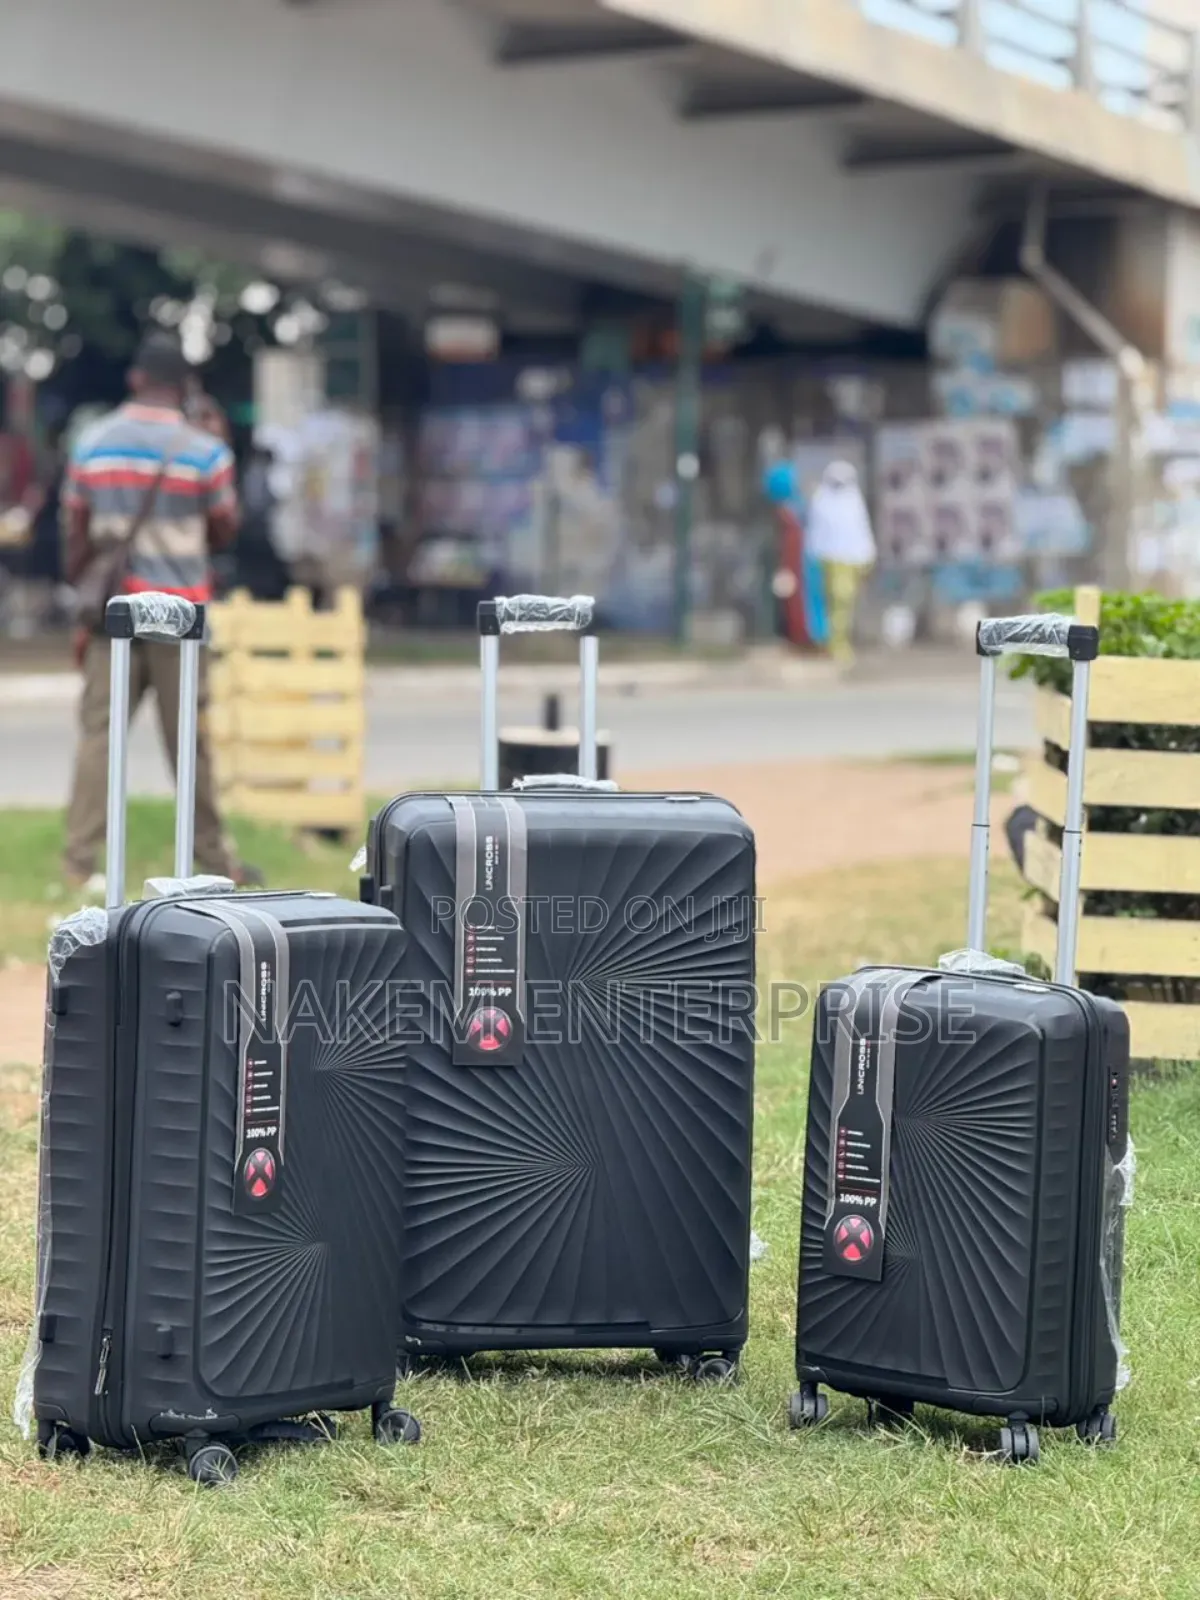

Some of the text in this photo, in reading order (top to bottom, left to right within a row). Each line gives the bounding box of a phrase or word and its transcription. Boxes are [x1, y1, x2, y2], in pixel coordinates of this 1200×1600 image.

[468, 986, 513, 997] 100% PP
[246, 1126, 277, 1139] 100% PP
[839, 1193, 877, 1207] 100% PP
